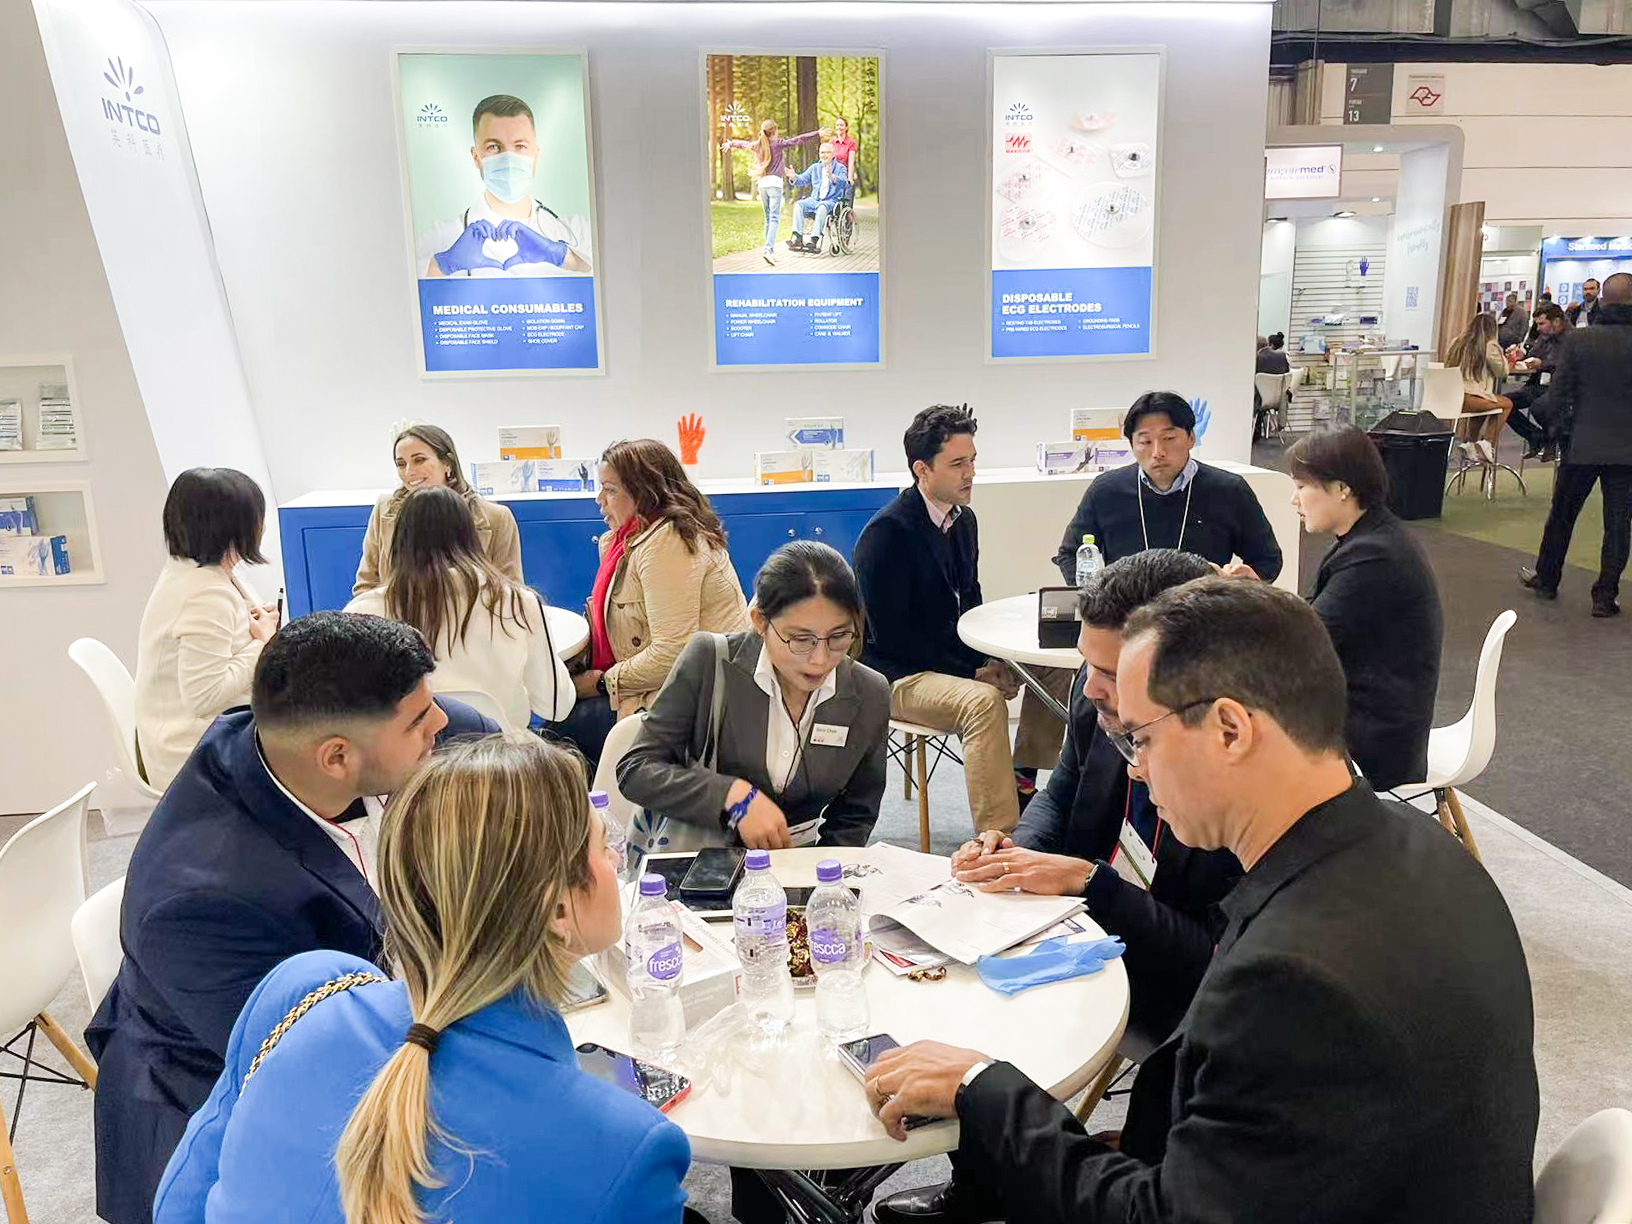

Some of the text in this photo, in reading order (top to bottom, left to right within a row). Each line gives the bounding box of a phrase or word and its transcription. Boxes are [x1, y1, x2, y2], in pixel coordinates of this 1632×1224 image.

[1350, 78, 1358, 92] 7
[101, 97, 160, 135] INTCO
[1348, 110, 1360, 122] 13
[726, 298, 863, 308] REHABILITATION EQUIPMENT
[1002, 292, 1073, 303] DISPOSABLE
[433, 303, 584, 315] MEDICAL CONSUMABLES
[1002, 303, 1102, 315] ECG ELECTRODES
